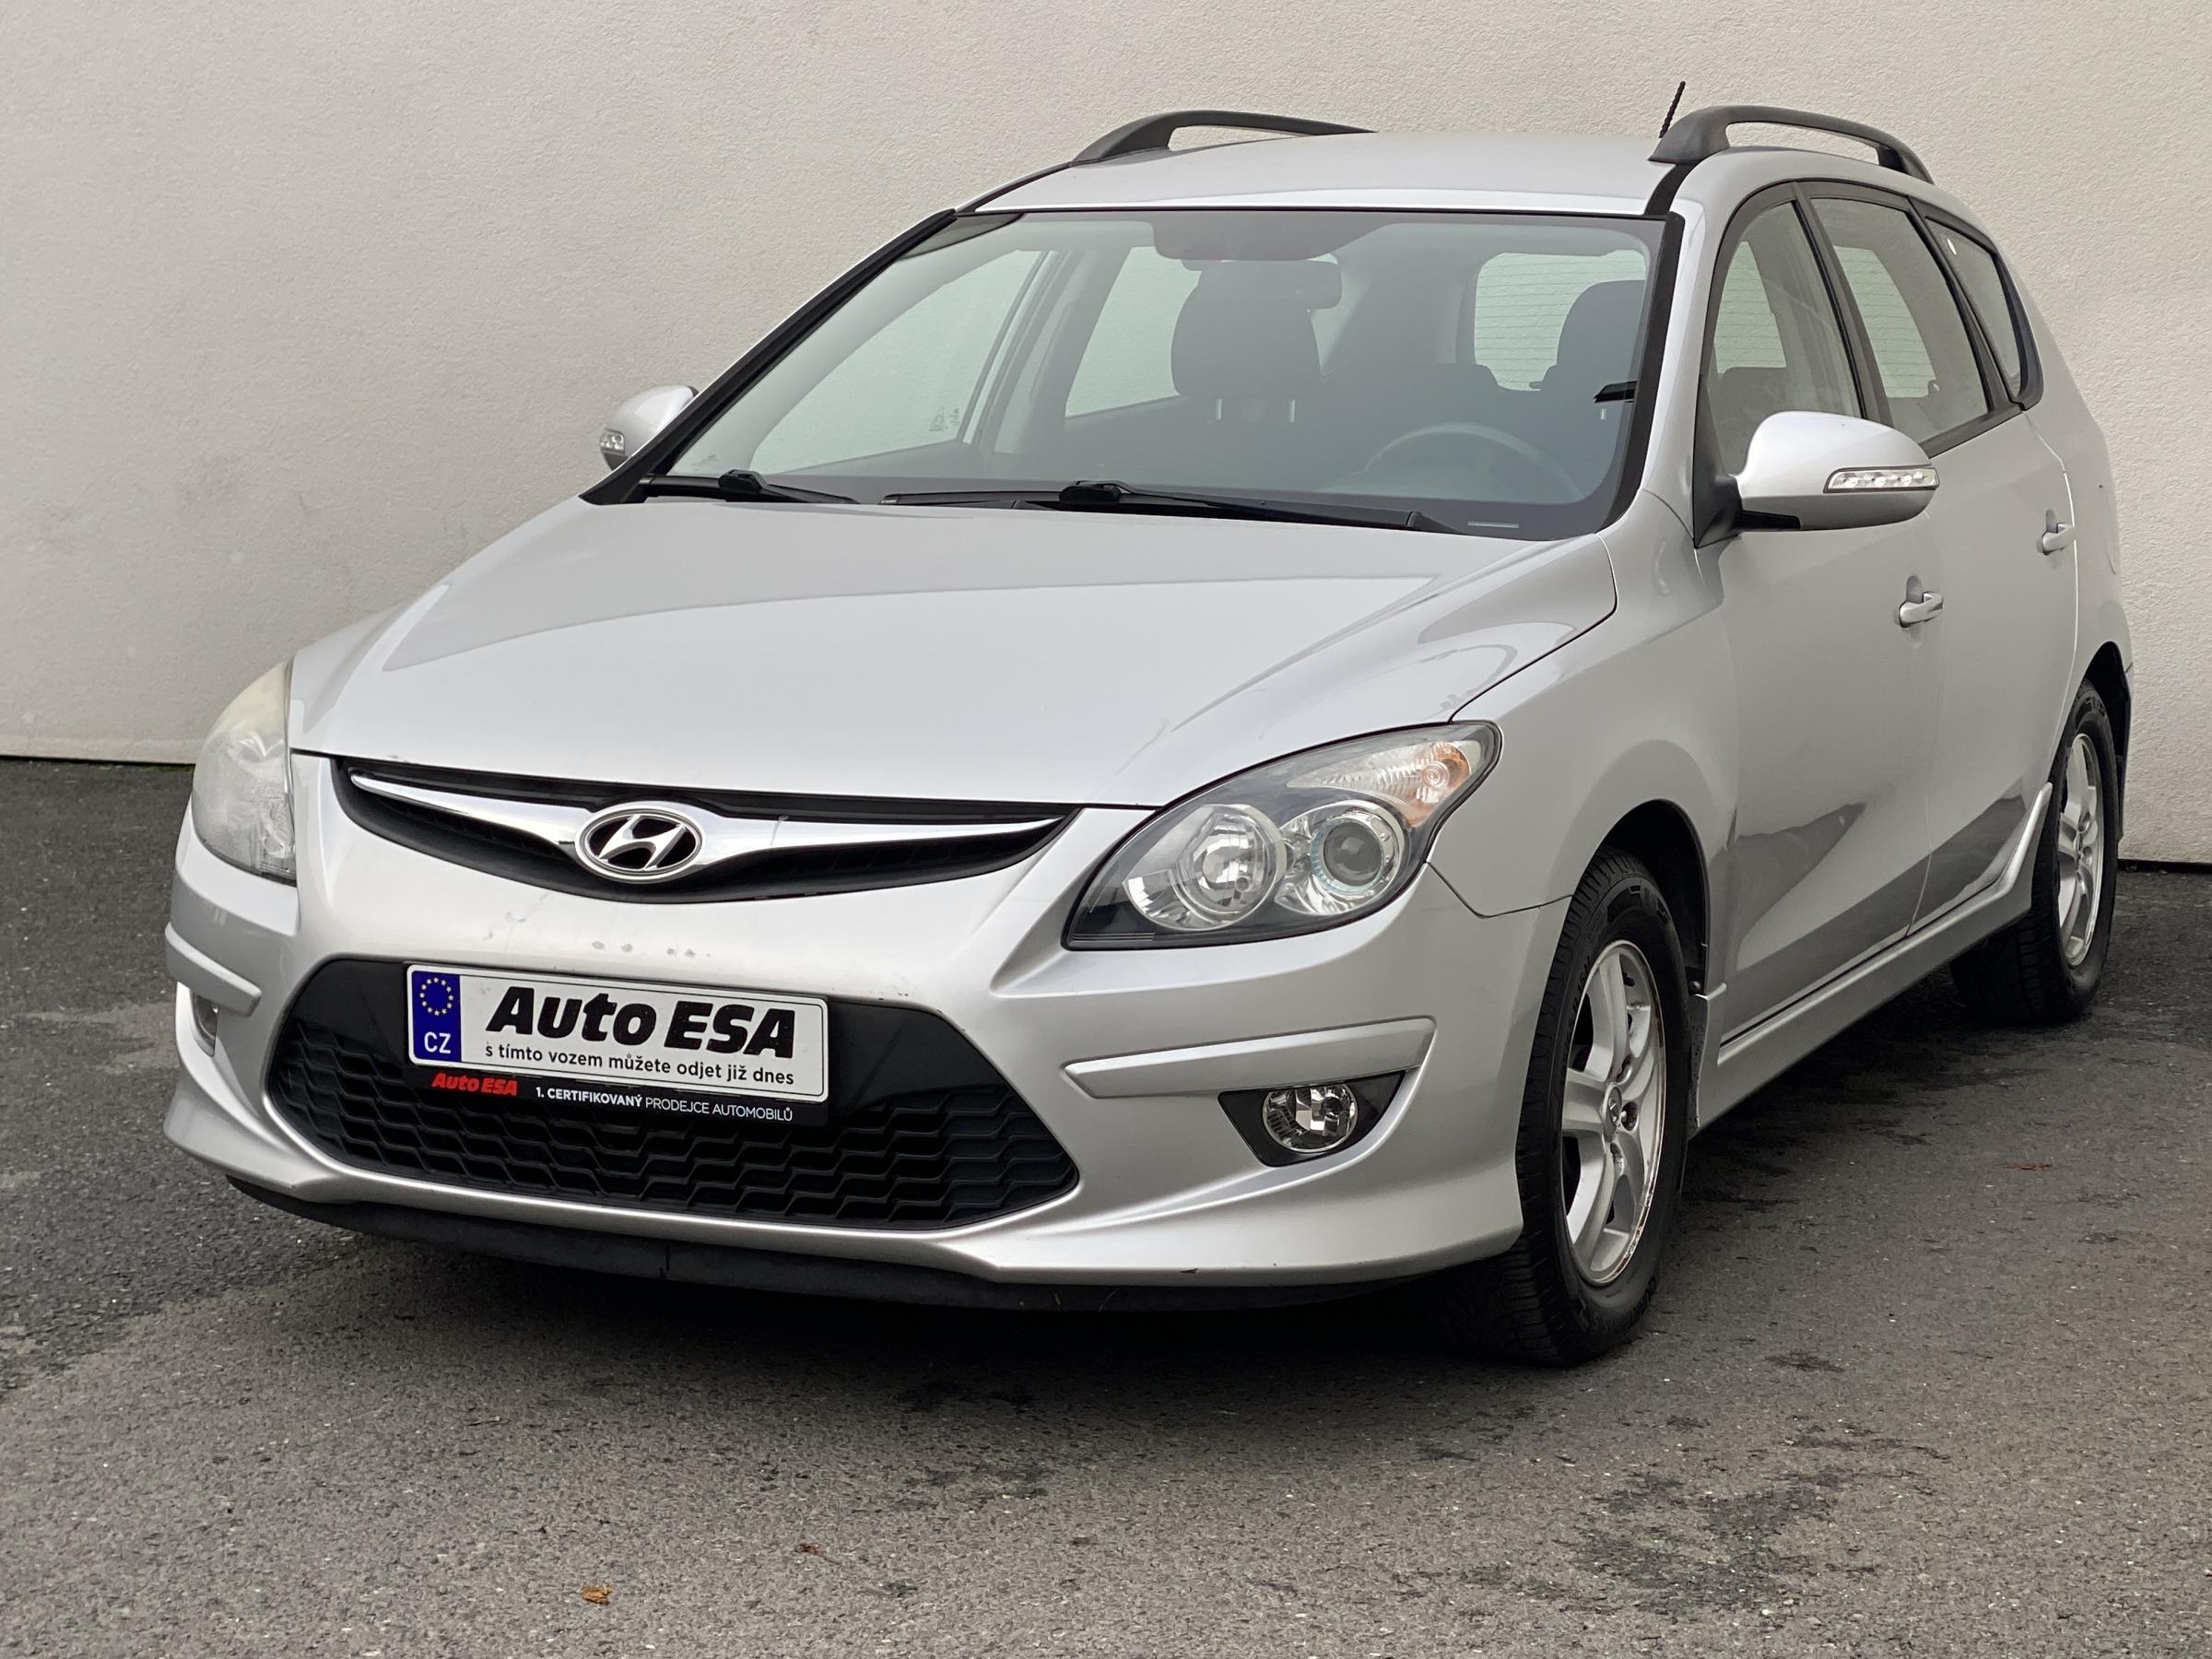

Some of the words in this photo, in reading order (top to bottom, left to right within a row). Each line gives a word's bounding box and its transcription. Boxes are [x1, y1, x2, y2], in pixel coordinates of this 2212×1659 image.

[486, 986, 656, 1045] Auto
[664, 1001, 794, 1058] ESA
[424, 1031, 452, 1054] CZ
[486, 1045, 493, 1057] s
[499, 1043, 543, 1062] tímto
[548, 1052, 603, 1067] vozem
[609, 1054, 671, 1074] můžete
[677, 1061, 722, 1079] odjet
[726, 1065, 747, 1081] již
[753, 1067, 794, 1085] dnes
[431, 1072, 479, 1091] Auto
[481, 1077, 518, 1096] ESA
[535, 1086, 545, 1099] 1.
[547, 1088, 643, 1108] CERTIFIKOVANÝ
[646, 1097, 711, 1114] PRODEJCE
[712, 1102, 793, 1122] AUTOMOBILŮ
